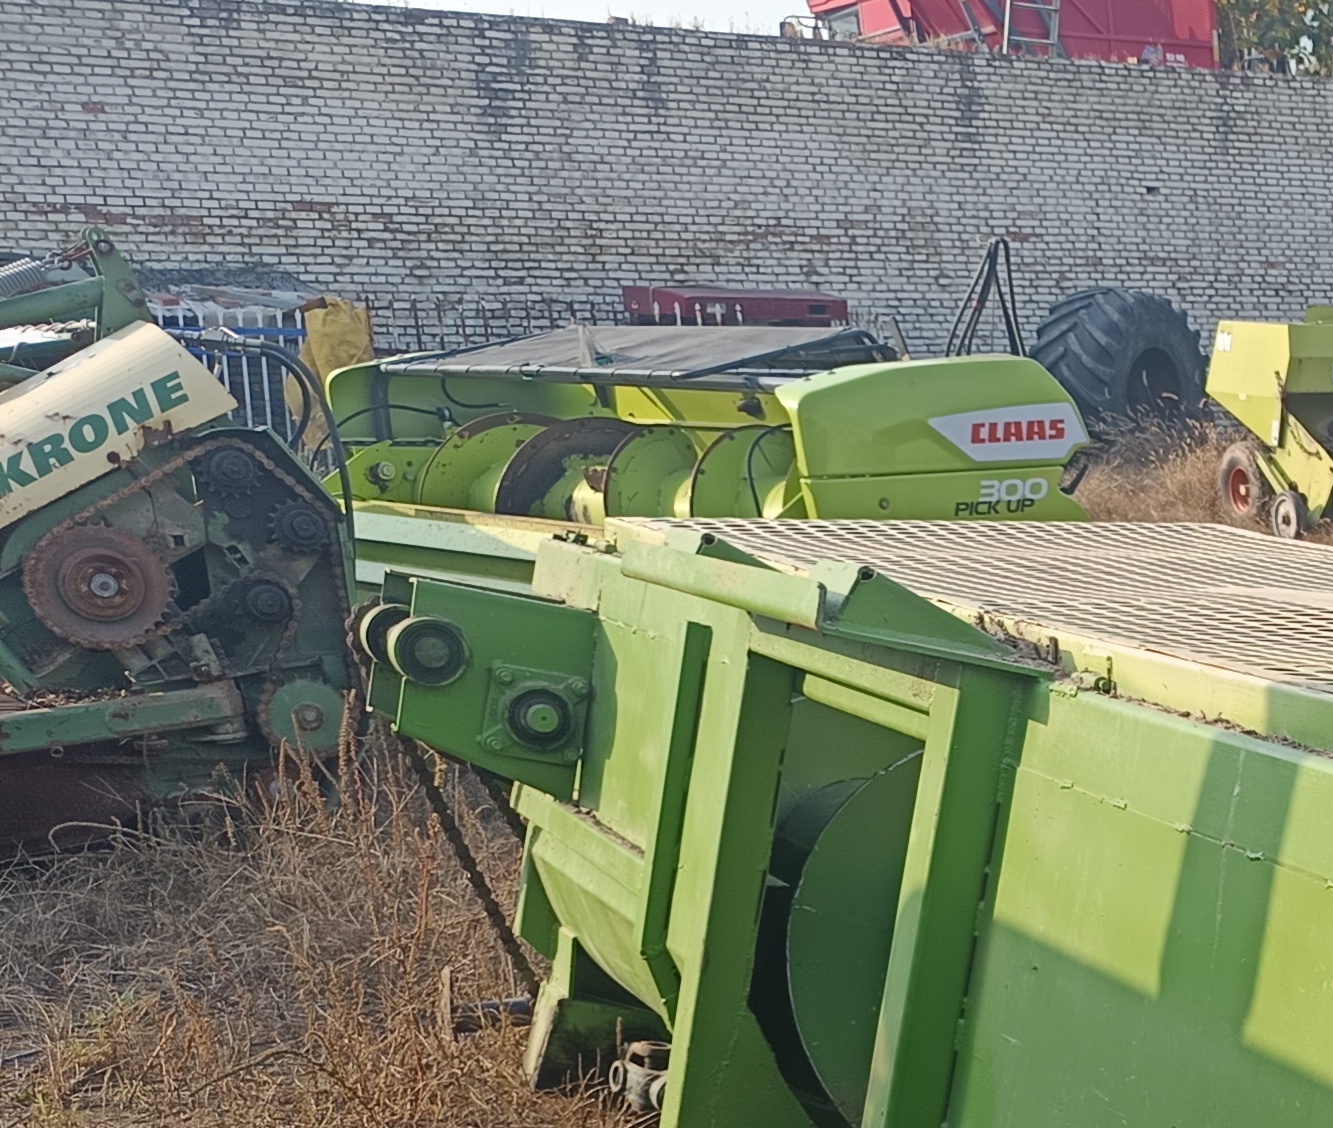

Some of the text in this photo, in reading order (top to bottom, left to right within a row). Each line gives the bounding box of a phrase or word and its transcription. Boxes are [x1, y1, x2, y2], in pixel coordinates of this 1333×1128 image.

[0, 371, 190, 500] KRONE
[971, 419, 1065, 444] CLAAS
[979, 477, 1048, 502] 300
[955, 498, 1035, 516] PICK UP
